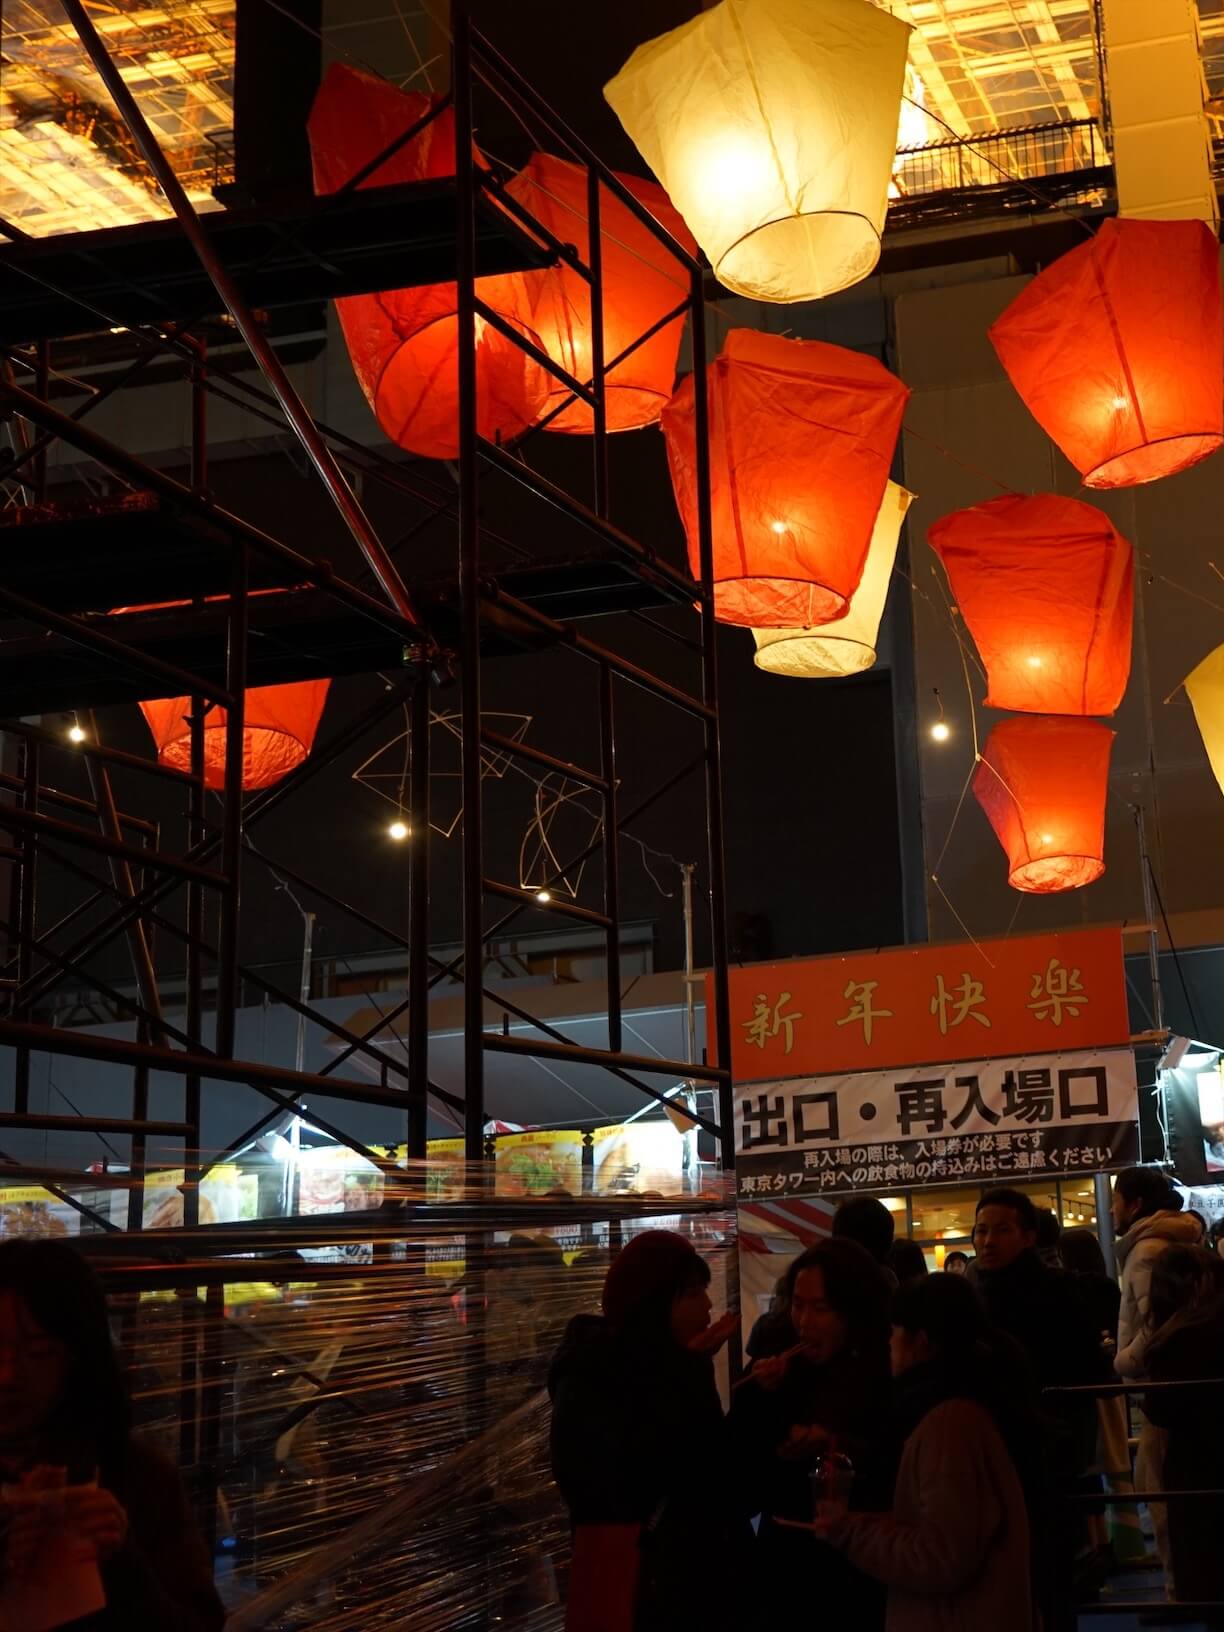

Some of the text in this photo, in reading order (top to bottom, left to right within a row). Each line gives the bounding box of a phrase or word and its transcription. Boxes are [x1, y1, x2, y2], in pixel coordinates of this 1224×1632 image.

[740, 958, 1089, 1055] 新年快楽
[741, 1066, 1110, 1150] 出口・再入場口
[740, 1147, 1113, 1193] 東京タワー内への飲食物の持込みはご遠慮ください
[804, 1130, 1044, 1169] 再入場の際は、入場券が必要です
